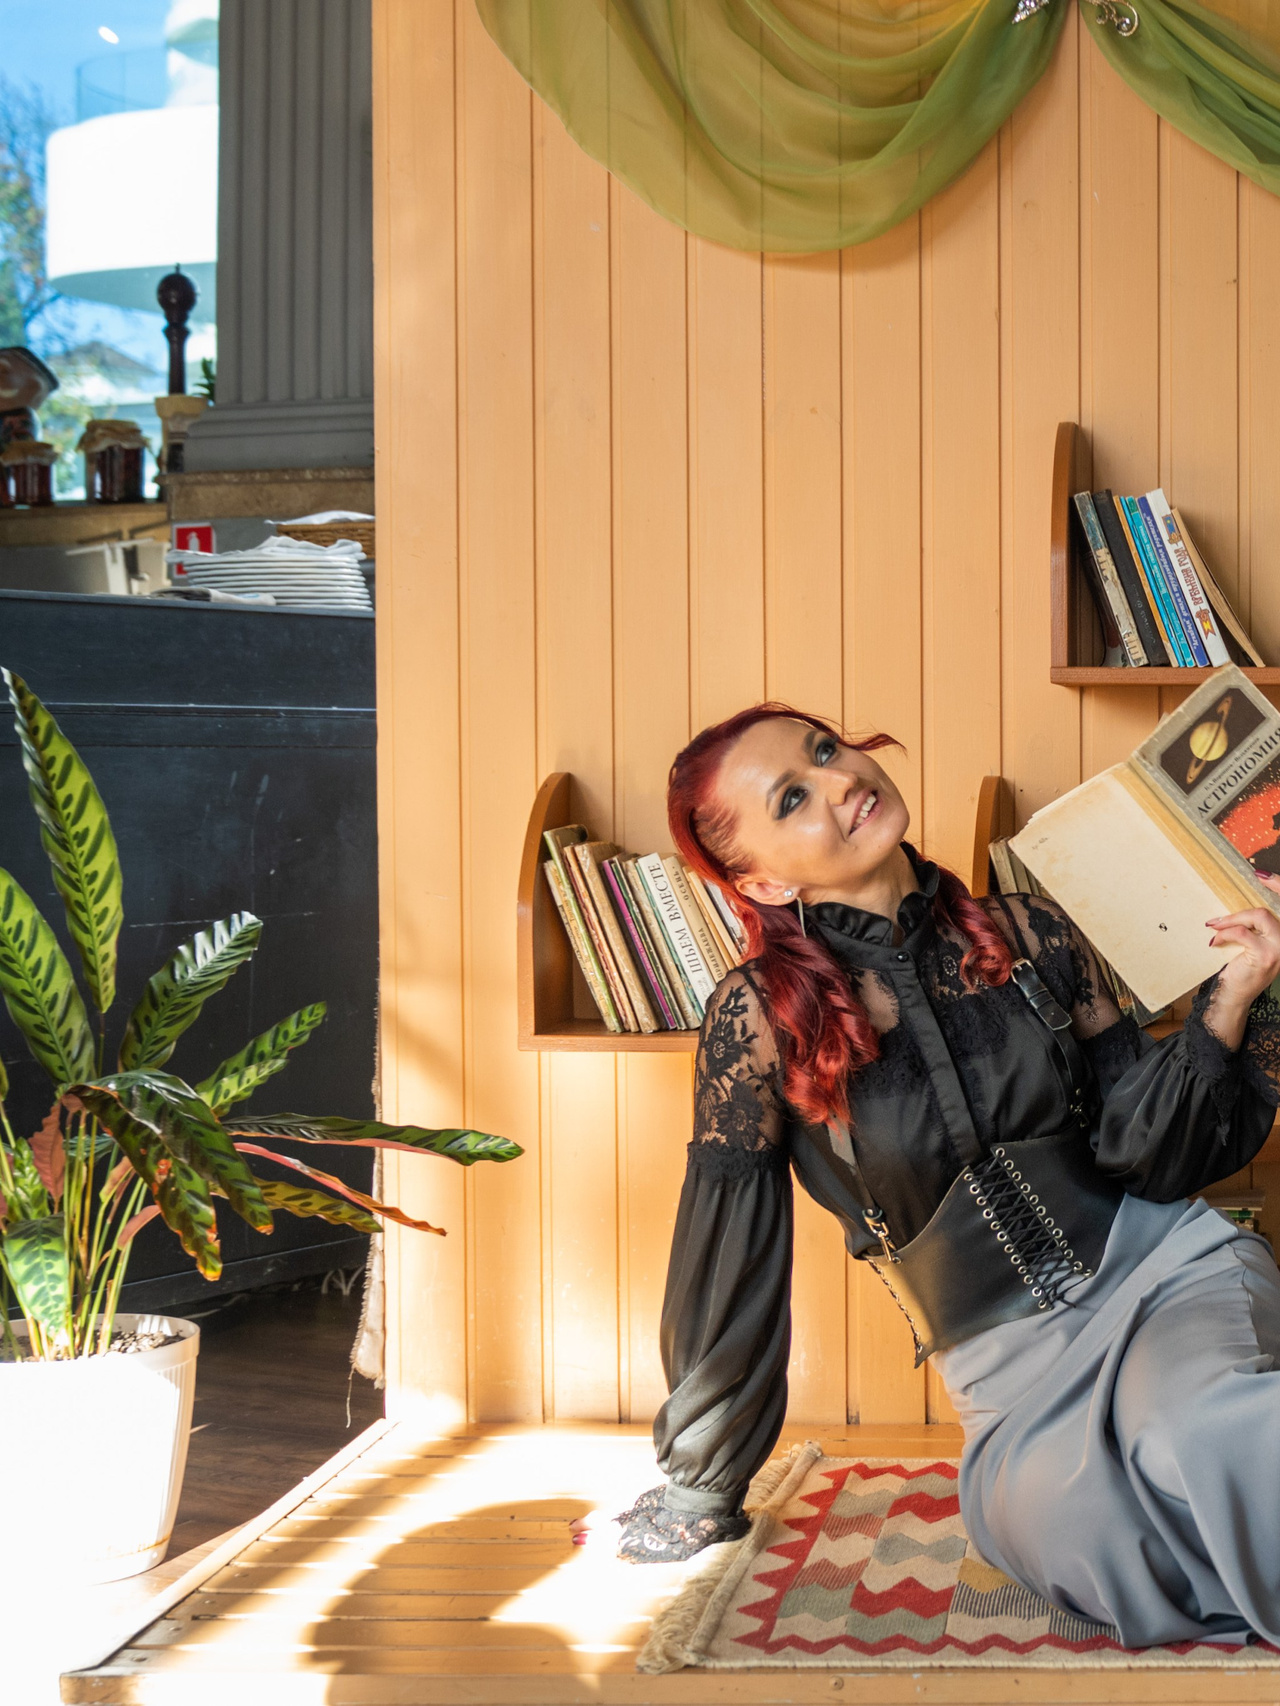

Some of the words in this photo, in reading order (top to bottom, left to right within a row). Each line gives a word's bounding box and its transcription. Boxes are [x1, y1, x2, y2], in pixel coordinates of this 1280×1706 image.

[1172, 545, 1191, 567] ГОДА
[646, 861, 682, 922] ВМЕСТЕ
[672, 869, 690, 901] ОСЕНЬ
[674, 926, 703, 974] ШЬЕМ
[697, 926, 724, 978] ПРИЛЕЖАЕВА
